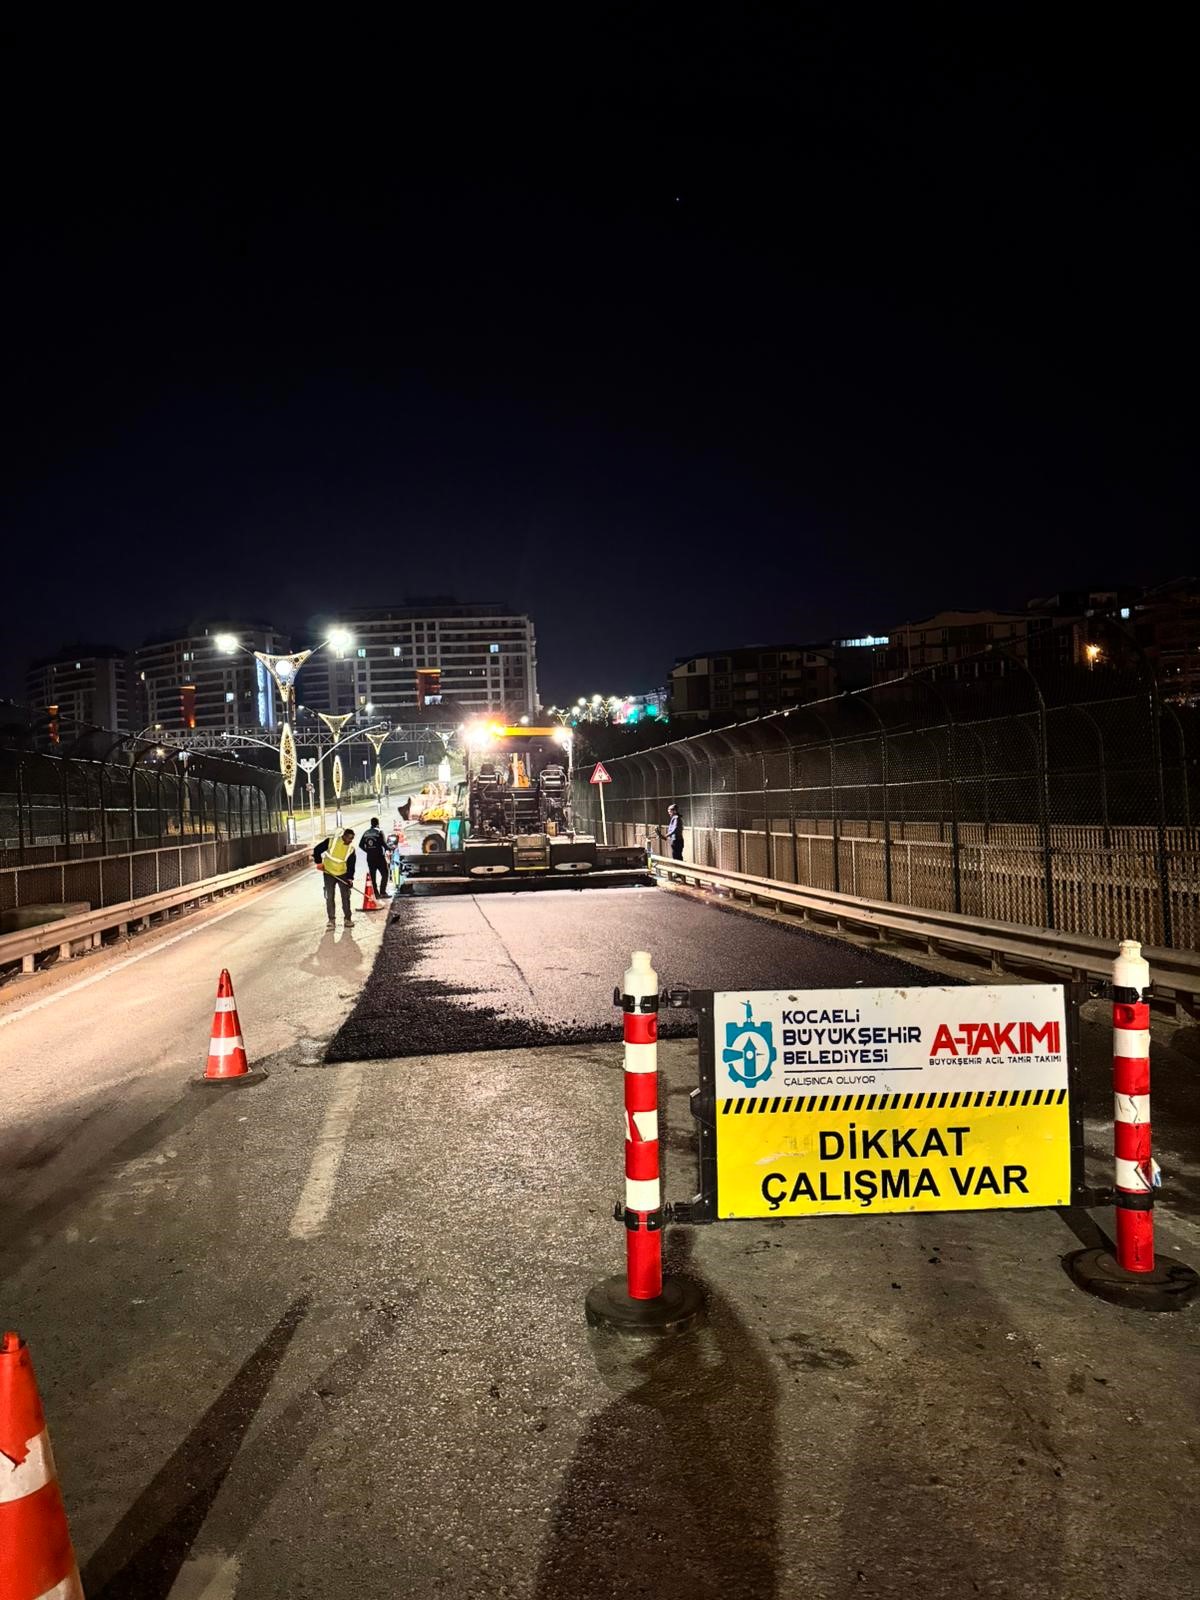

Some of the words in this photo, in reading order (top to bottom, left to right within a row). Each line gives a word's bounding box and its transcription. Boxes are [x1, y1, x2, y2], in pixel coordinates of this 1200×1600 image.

[930, 1021, 1060, 1057] A-TAKIMI
[1035, 1055, 1061, 1063] TAKIMI
[784, 1076, 833, 1087] ÇALIŞINCA
[836, 1075, 876, 1085] OLUYOR
[819, 1122, 970, 1161] DİKKAT
[761, 1169, 940, 1210] ÇALIŞMA
[950, 1165, 1029, 1196] VAR
